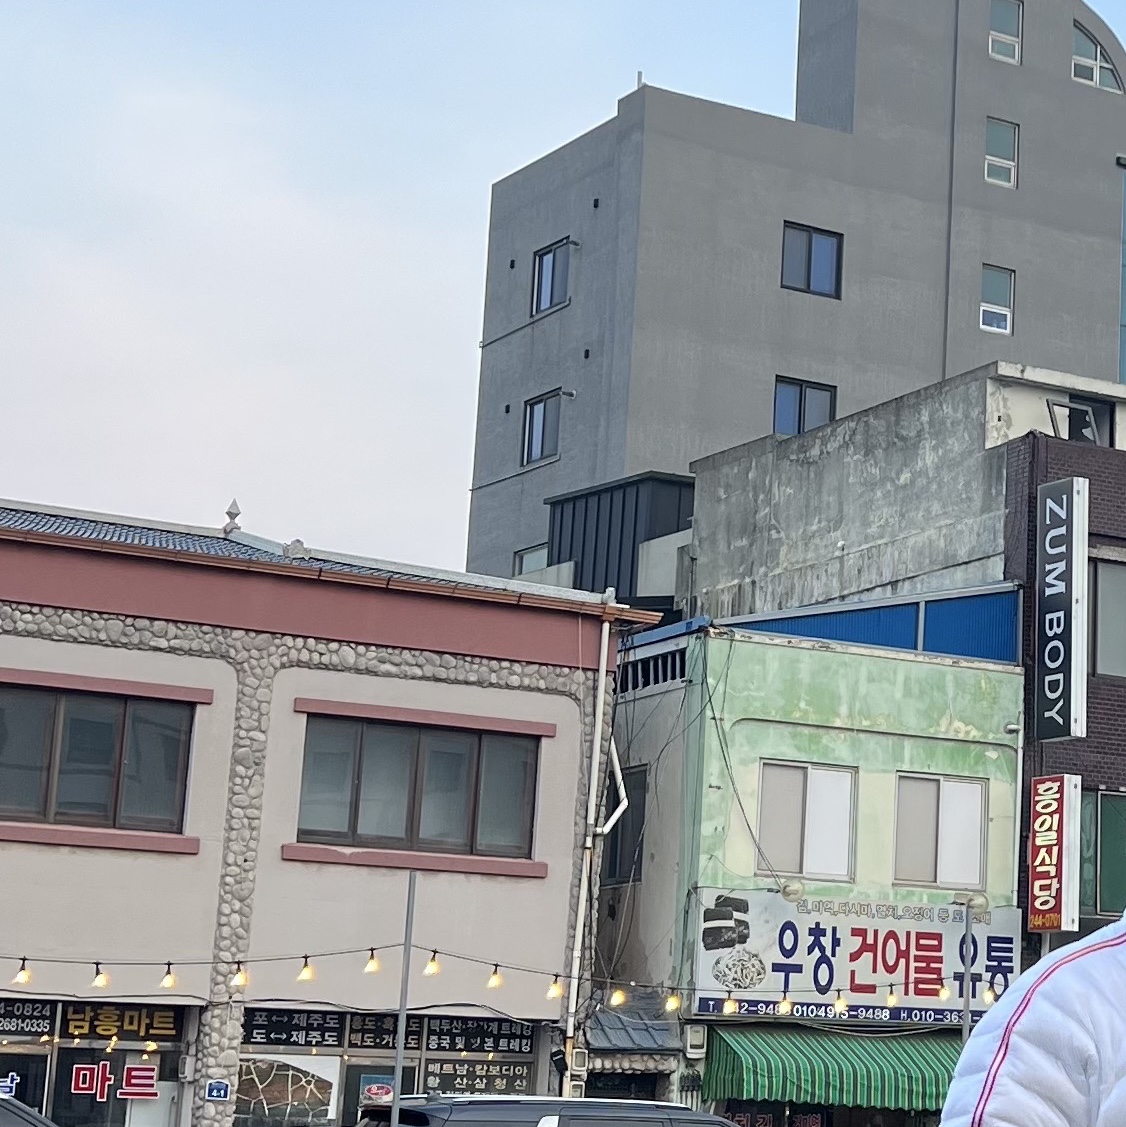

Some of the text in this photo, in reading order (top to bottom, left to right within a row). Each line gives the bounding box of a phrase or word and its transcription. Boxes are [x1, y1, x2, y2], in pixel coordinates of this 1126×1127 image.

[1044, 494, 1068, 726] ZUM BODY
[1033, 781, 1060, 911] 흥일식당
[772, 920, 1014, 1002] 우창 건어물 유통
[67, 1006, 176, 1036] 남흥마트
[292, 1013, 340, 1028] 제주도
[501, 1021, 532, 1036] 트레킹
[290, 1031, 339, 1045] 제주도
[350, 1033, 419, 1048] 백도·거도
[428, 1036, 450, 1050] 중국
[455, 1036, 466, 1050] 및
[498, 1038, 531, 1052] 트레킹
[71, 1061, 160, 1101] 마트
